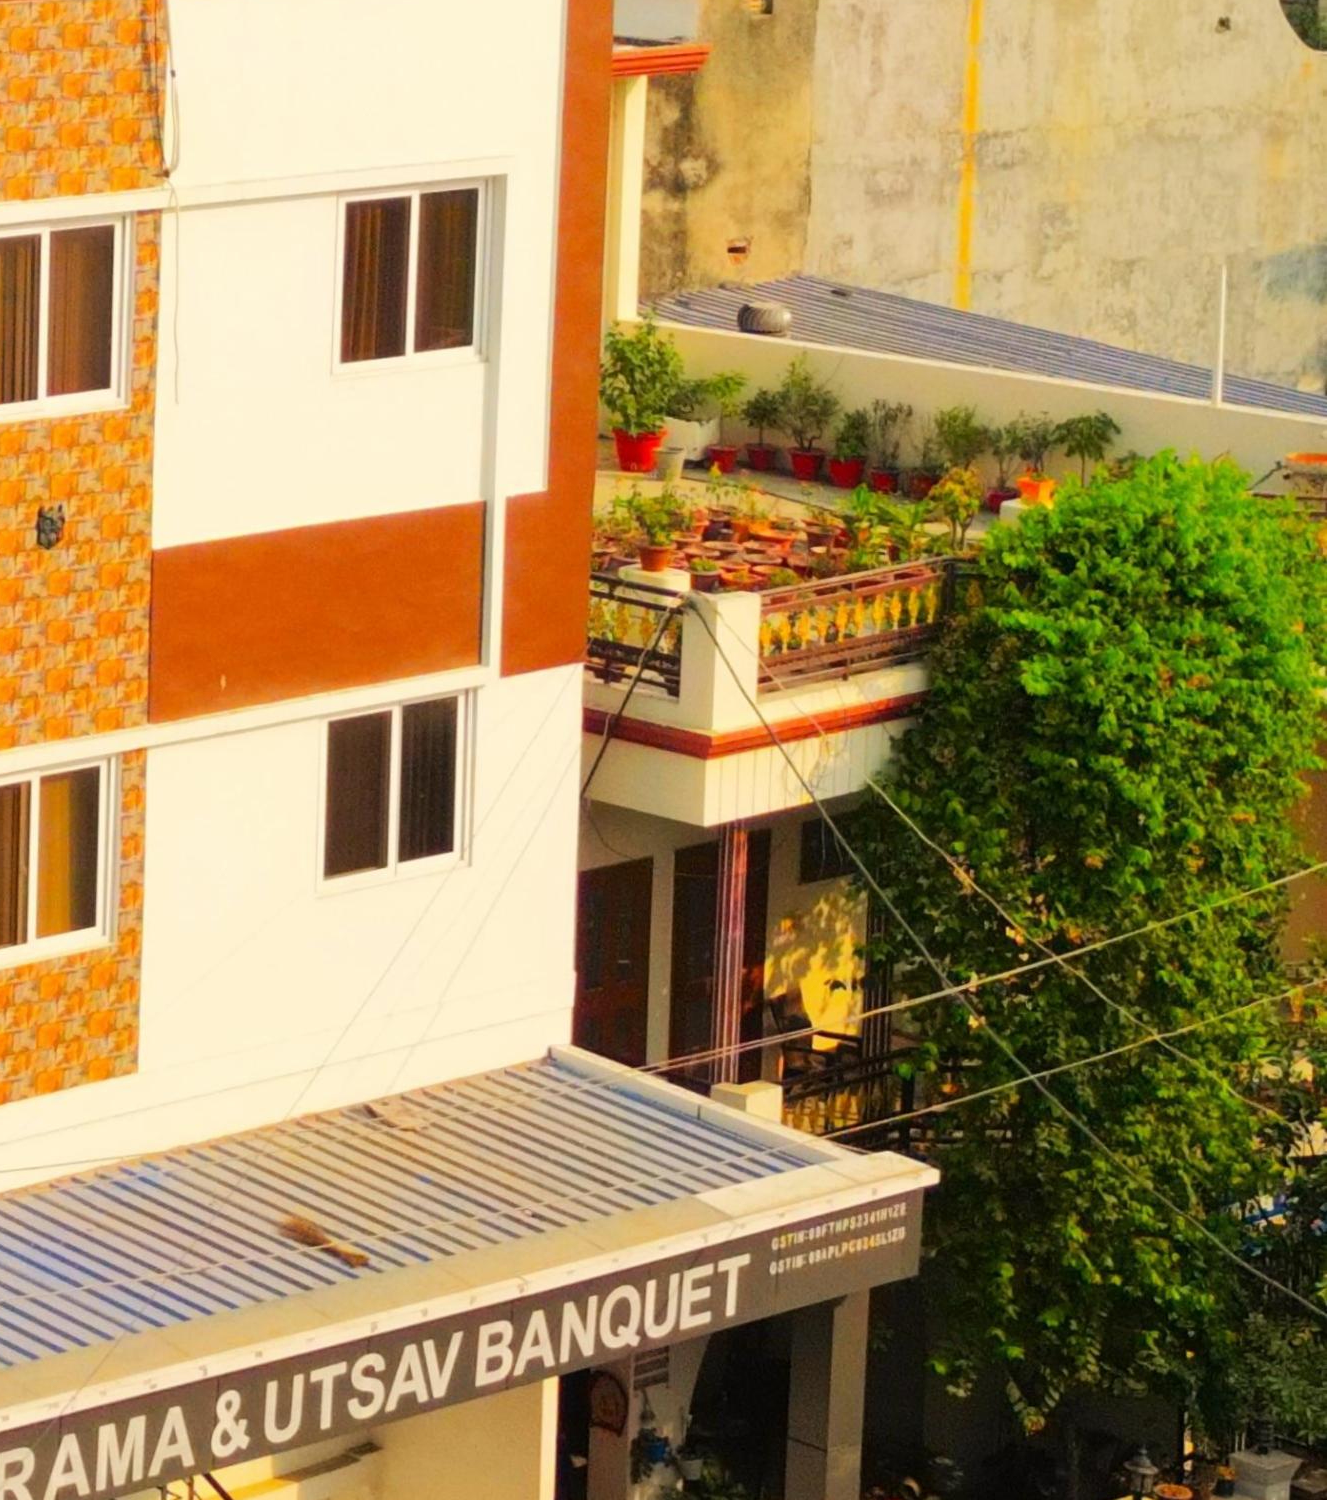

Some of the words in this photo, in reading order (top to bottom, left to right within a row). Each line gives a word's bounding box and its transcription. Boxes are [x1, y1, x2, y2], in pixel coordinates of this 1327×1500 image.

[211, 1389, 251, 1458] &
[264, 1331, 463, 1444] UTSAV
[475, 1254, 751, 1388] BANQUET
